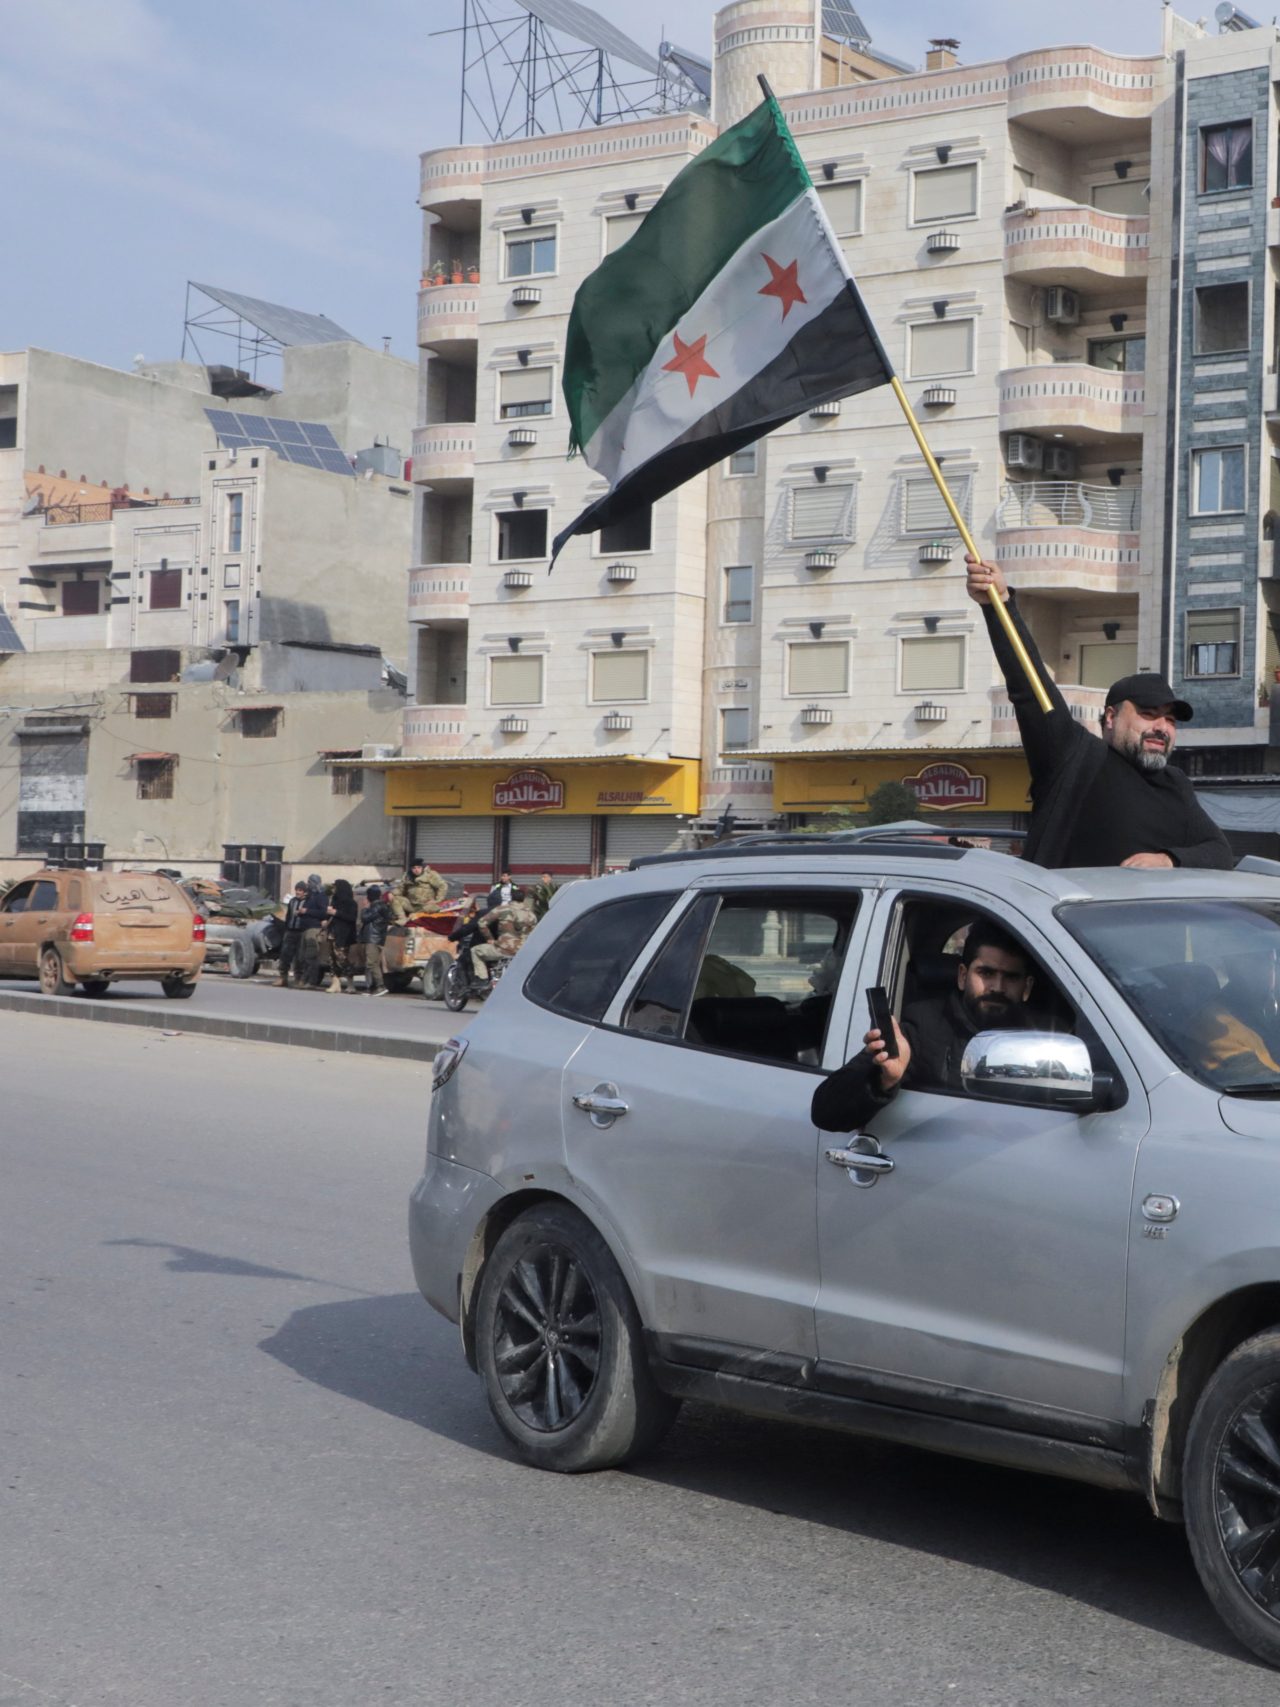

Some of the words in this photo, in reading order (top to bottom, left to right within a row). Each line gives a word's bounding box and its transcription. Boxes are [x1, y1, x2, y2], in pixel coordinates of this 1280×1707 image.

[495, 785, 560, 805] الصالحين
[597, 791, 643, 802] ALSALHIN
[914, 779, 982, 801] الصالحي
[99, 886, 171, 905] شاهين
